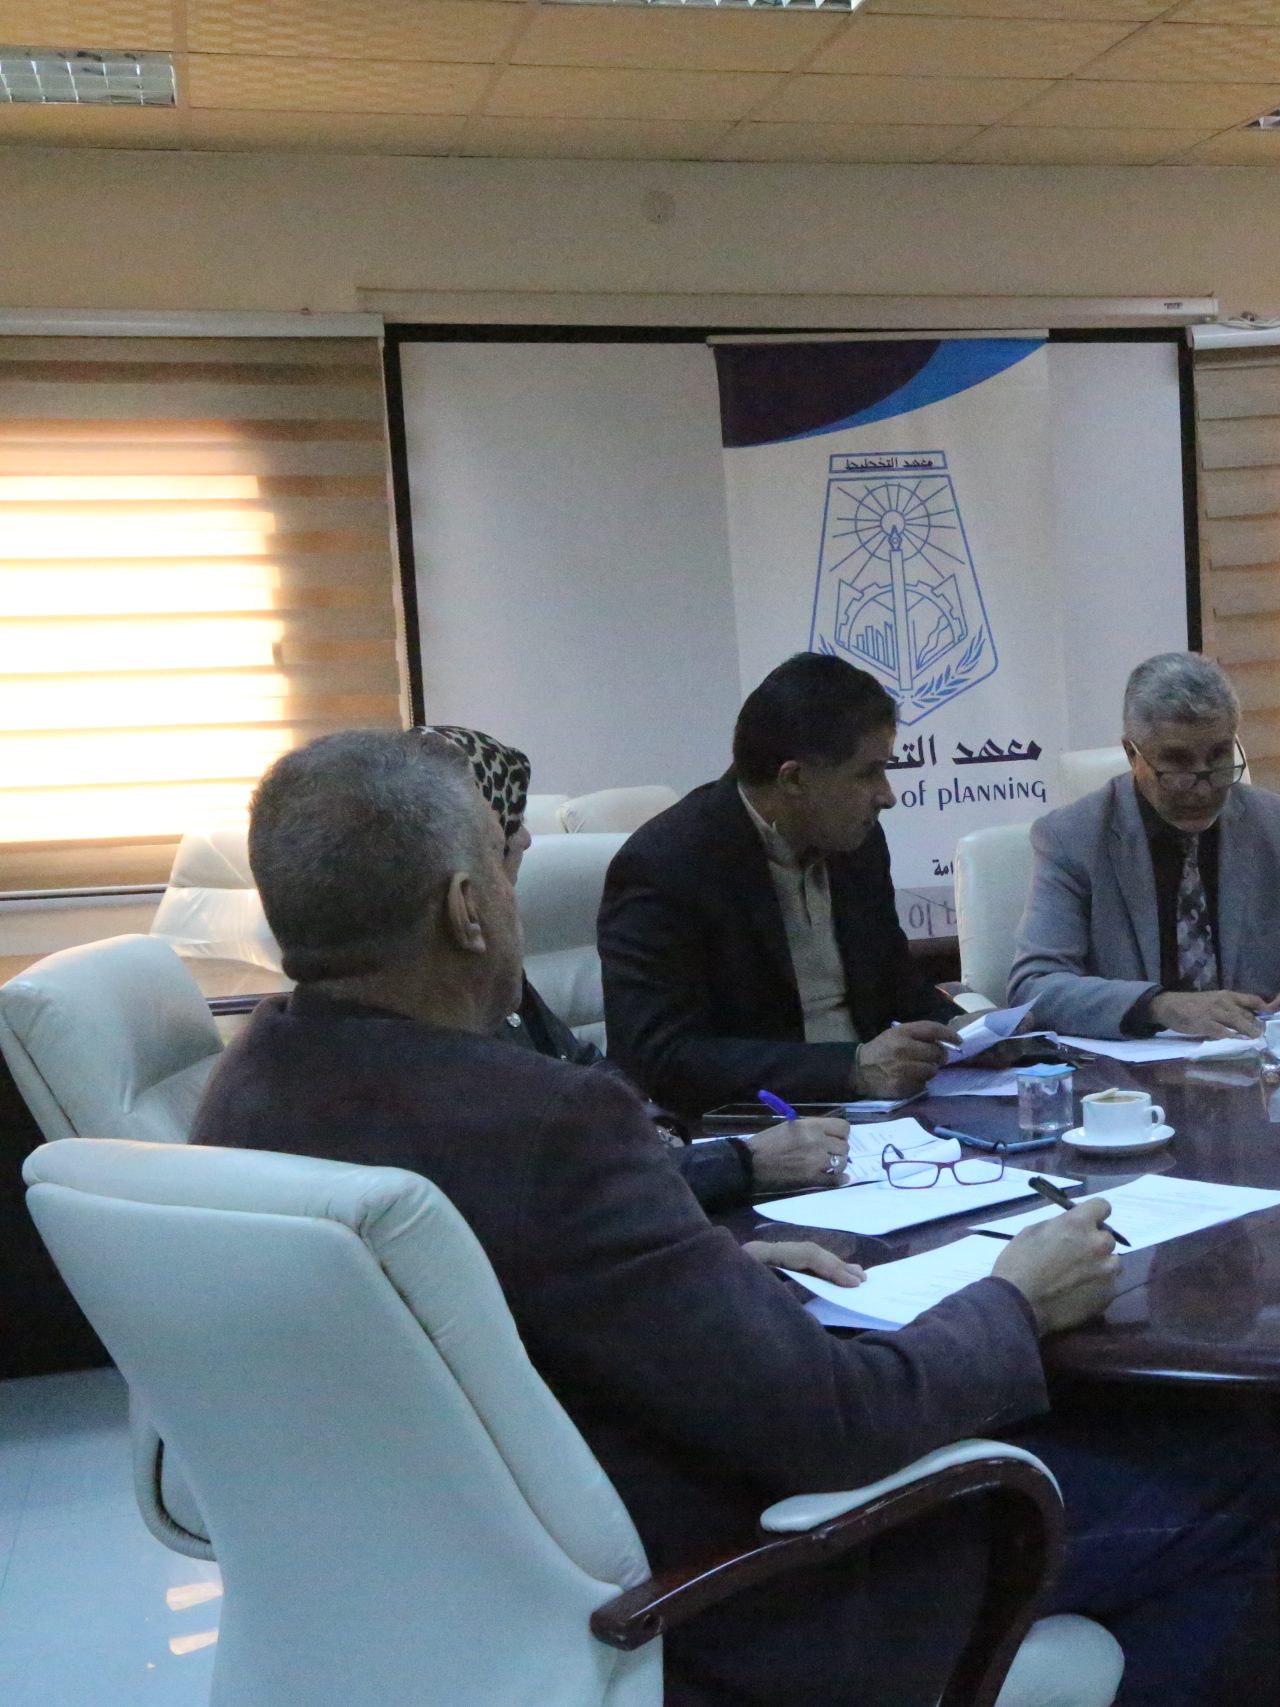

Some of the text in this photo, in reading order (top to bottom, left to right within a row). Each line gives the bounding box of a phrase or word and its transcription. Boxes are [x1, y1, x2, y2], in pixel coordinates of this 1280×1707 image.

[845, 457, 933, 470] معهد التخطيط
[951, 738, 1043, 765] معهد
[901, 780, 926, 808] of
